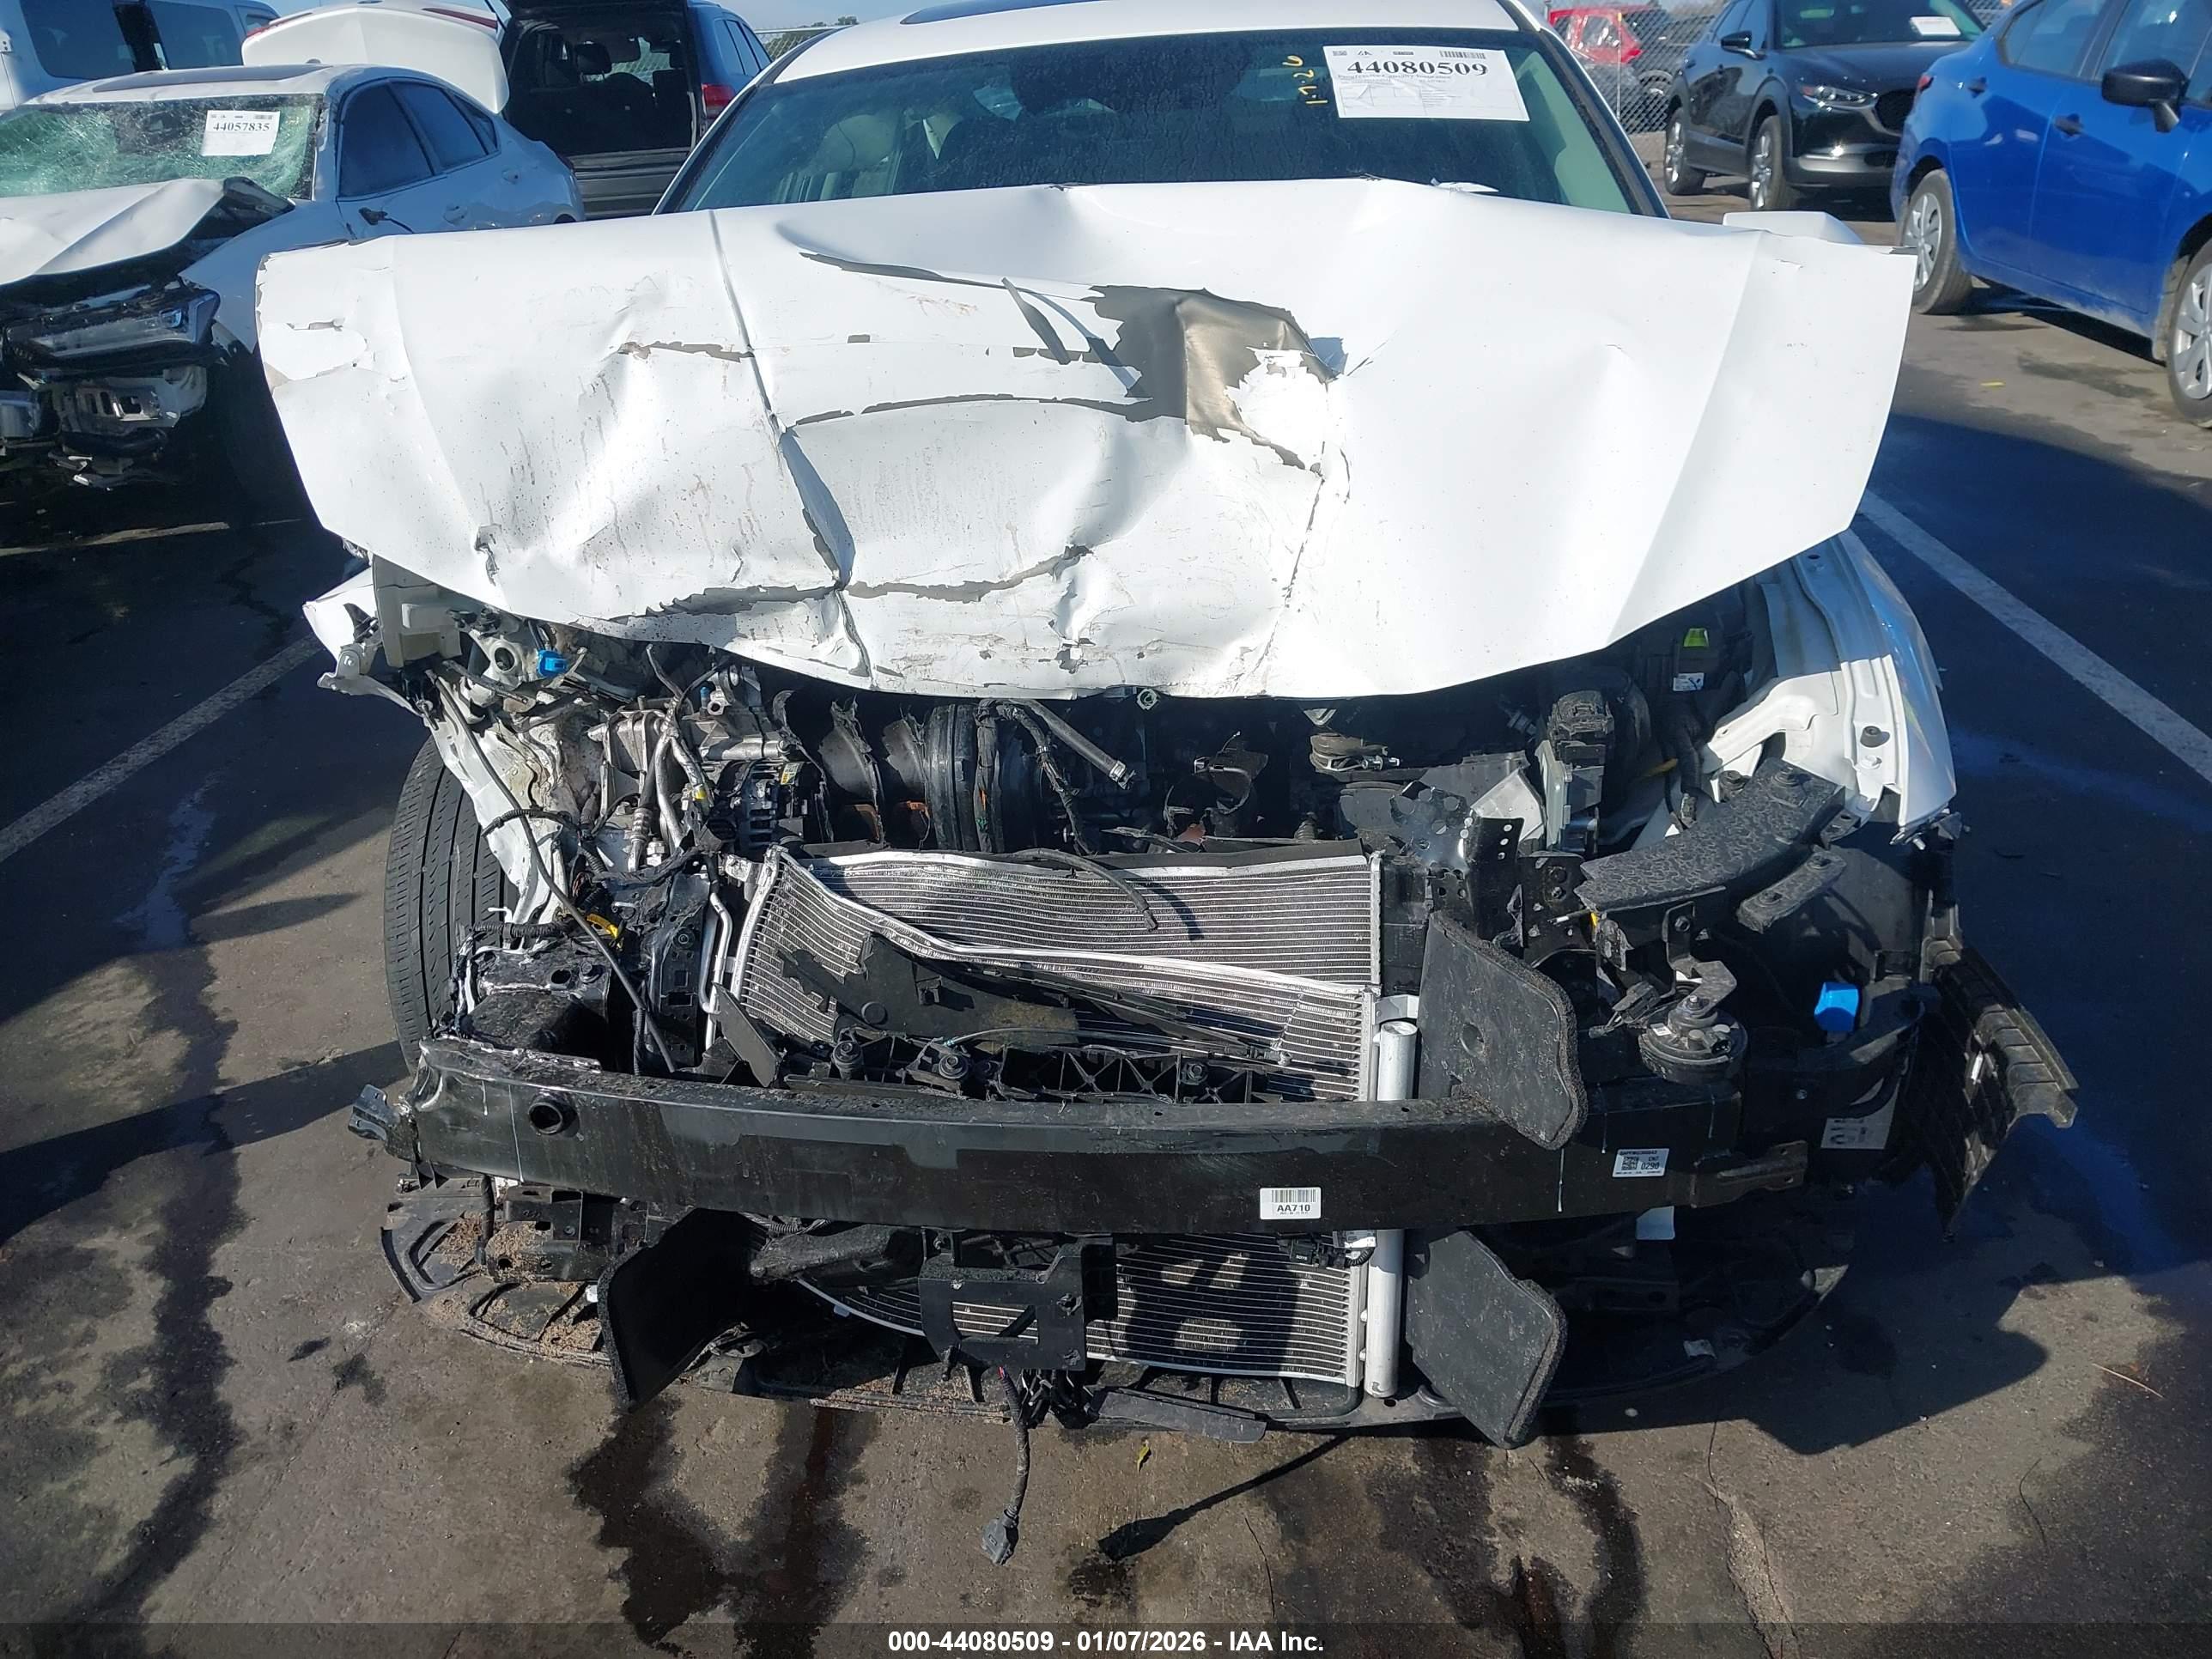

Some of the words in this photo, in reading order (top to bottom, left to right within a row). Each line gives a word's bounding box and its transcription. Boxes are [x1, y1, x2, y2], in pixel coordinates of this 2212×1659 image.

[1347, 60, 1487, 76] 44080509
[213, 122, 270, 131] 44057835
[1641, 1162, 1660, 1170] 0290
